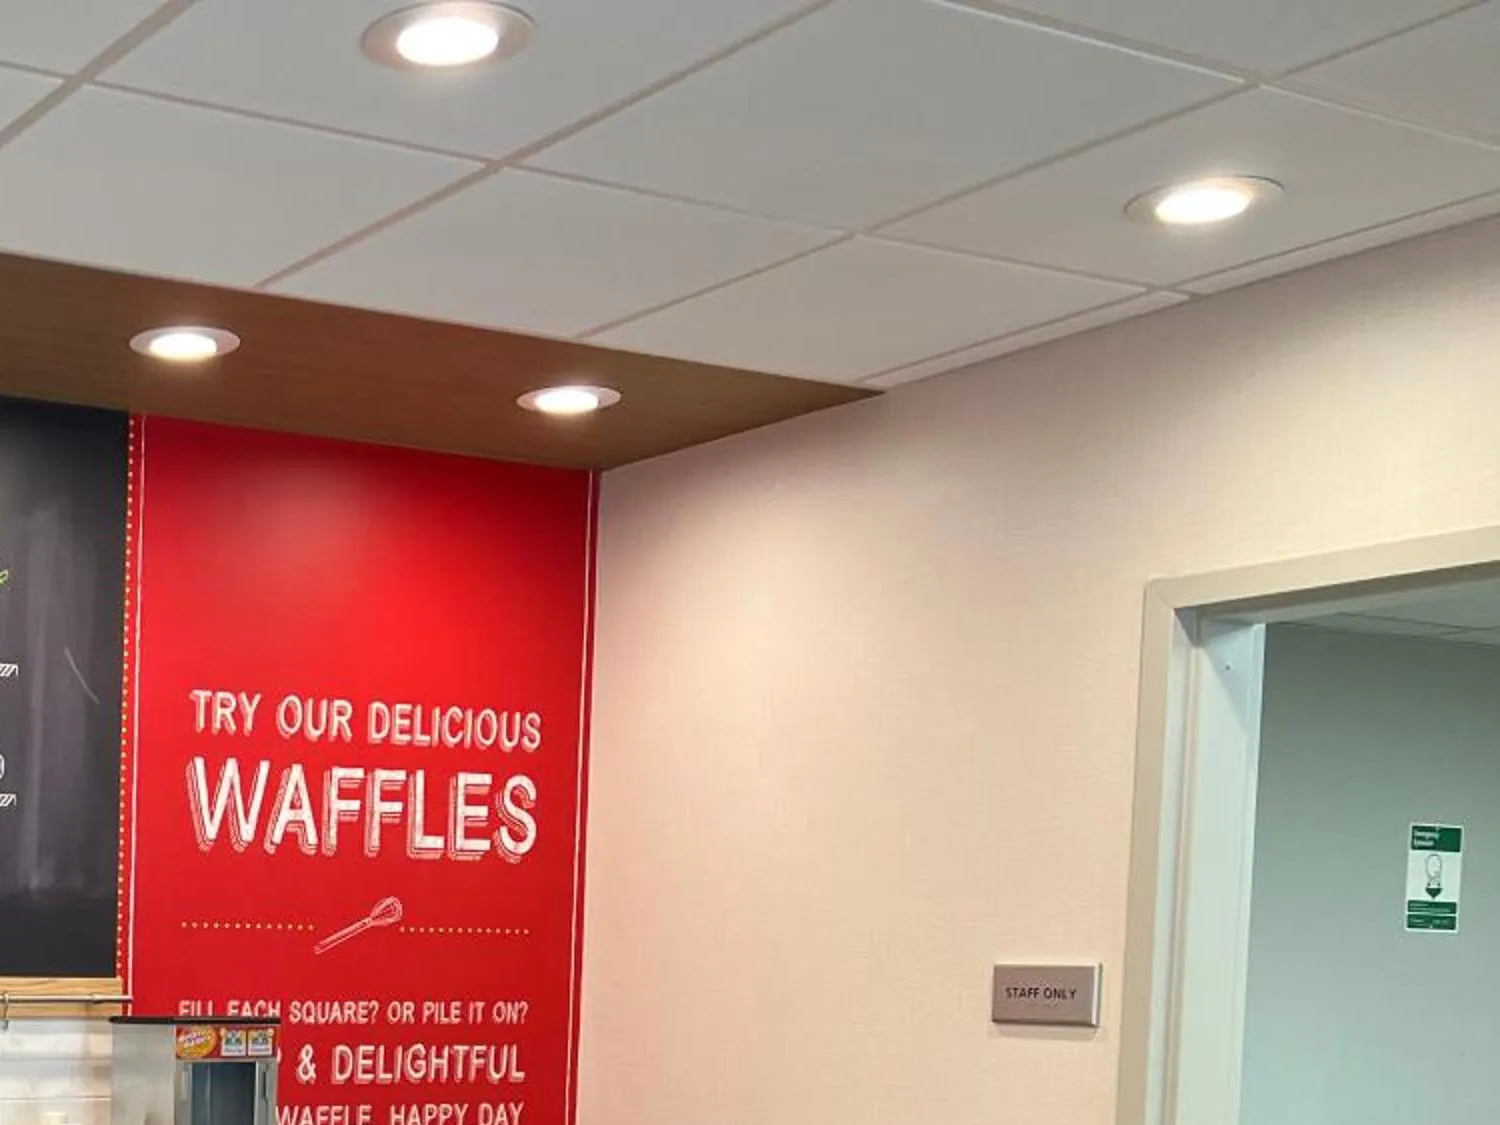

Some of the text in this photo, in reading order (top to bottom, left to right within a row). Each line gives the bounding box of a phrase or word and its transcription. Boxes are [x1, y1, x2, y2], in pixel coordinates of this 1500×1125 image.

[189, 689, 542, 753] TRY OUR DELICIOUS
[186, 756, 538, 864] WAFFLES
[289, 1000, 379, 1024] SQUARE?
[387, 1001, 415, 1024] OR
[423, 1001, 461, 1024] PILE
[468, 1001, 485, 1024] IT
[492, 1001, 528, 1024] ON?
[1005, 987, 1077, 1000] STAFF ONLY
[296, 1043, 317, 1083] &
[332, 1043, 525, 1084] DELIGHTFUL
